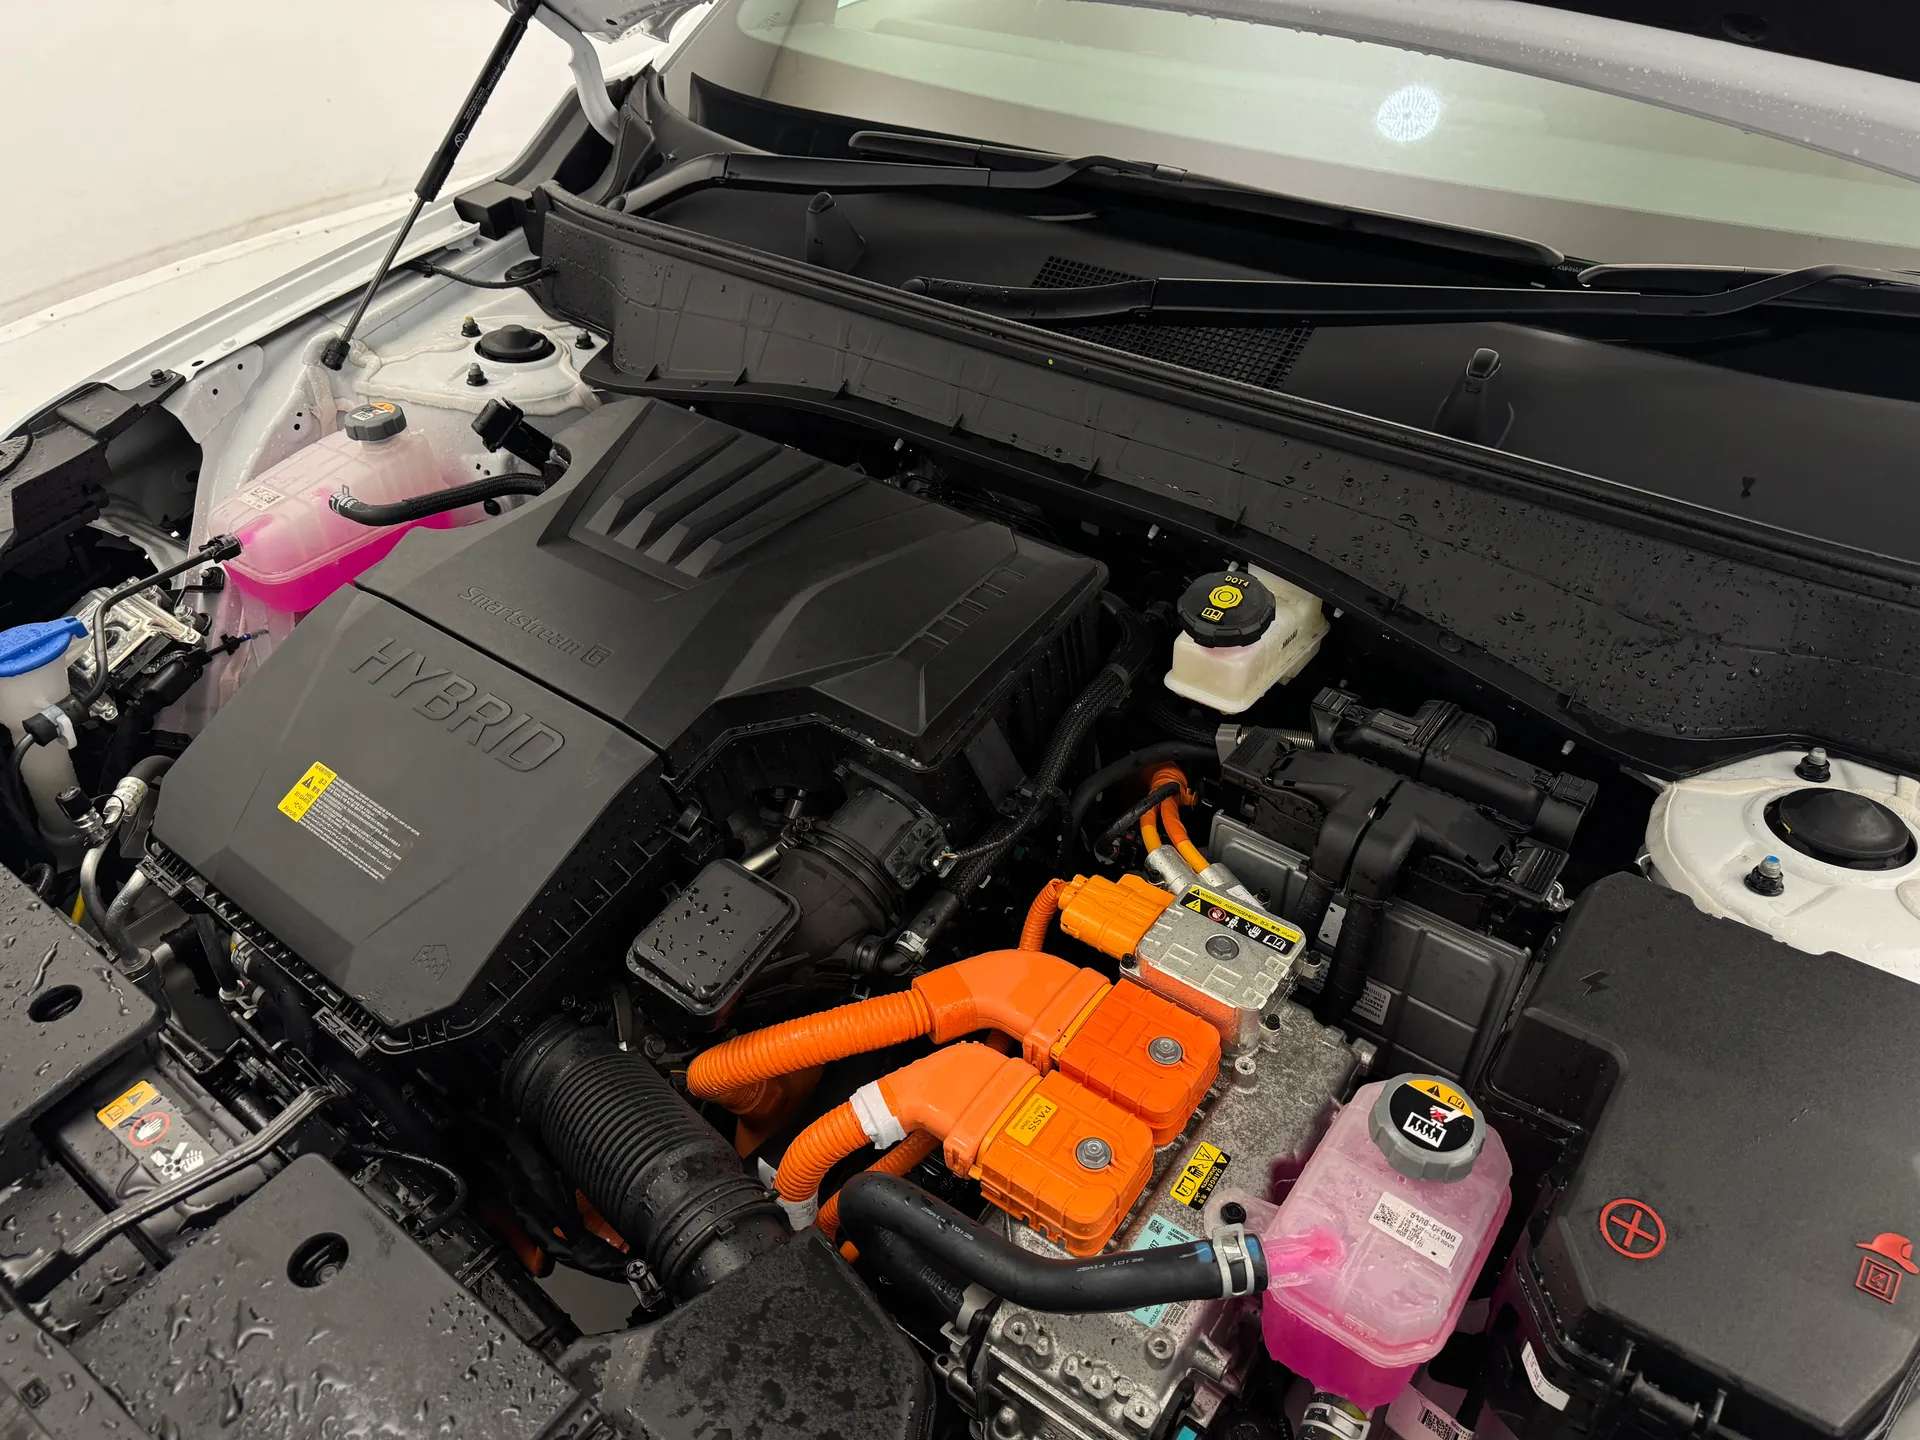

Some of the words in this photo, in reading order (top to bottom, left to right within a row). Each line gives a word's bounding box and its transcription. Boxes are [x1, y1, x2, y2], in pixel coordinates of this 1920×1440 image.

[1225, 575, 1250, 587] DOT4
[457, 584, 582, 656] Smartstream
[351, 638, 566, 773] HYBRID
[1028, 1105, 1052, 1132] PASS
[1206, 1168, 1223, 1191] DANGER
